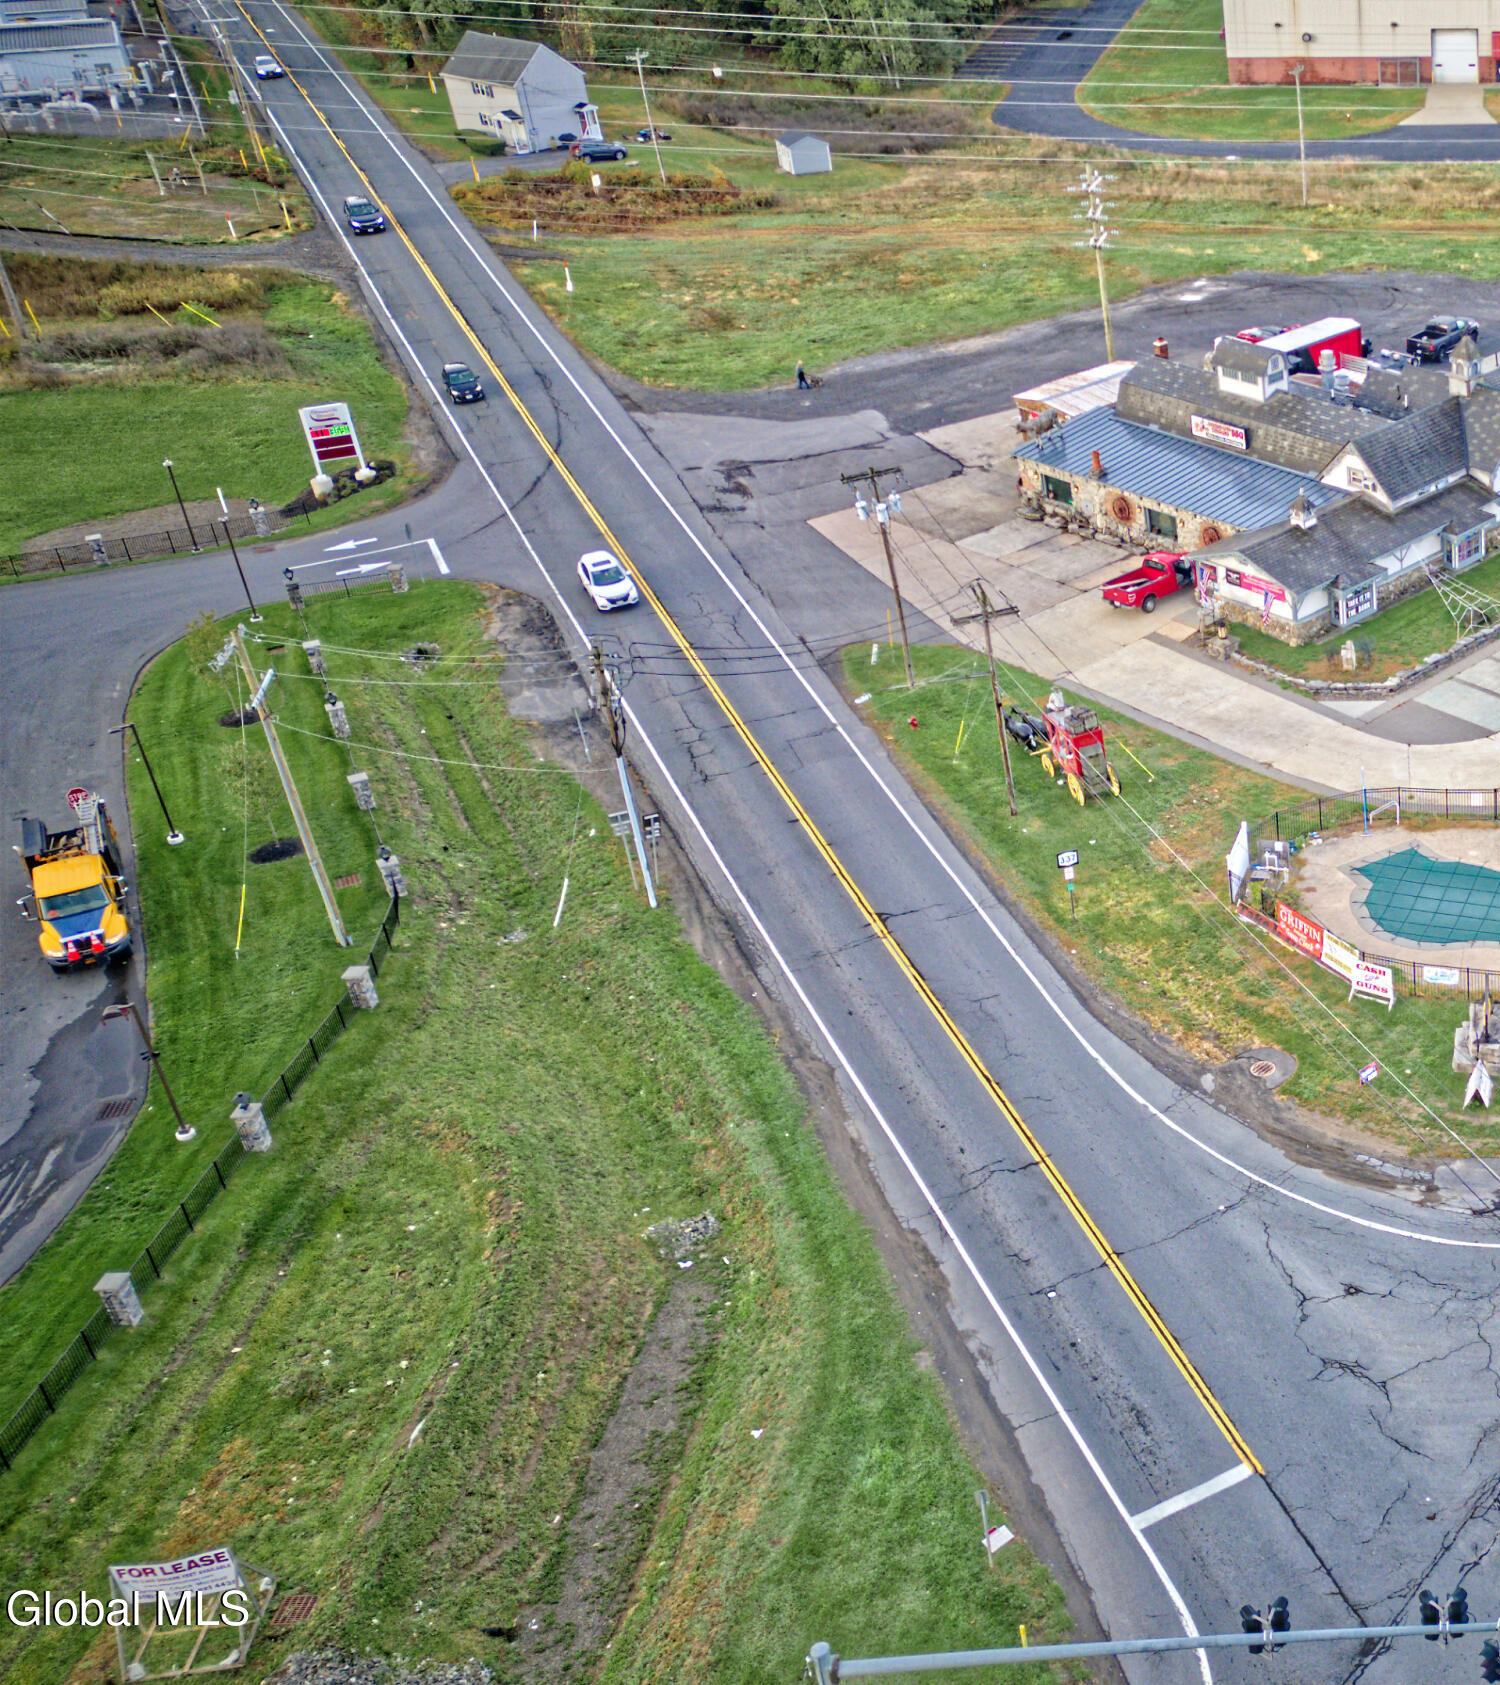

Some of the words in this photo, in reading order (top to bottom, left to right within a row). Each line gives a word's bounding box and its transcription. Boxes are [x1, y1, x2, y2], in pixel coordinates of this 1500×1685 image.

[1279, 909, 1321, 943] GRIFFIN
[1356, 963, 1386, 977] CASH
[1356, 981, 1389, 994] GUNS
[116, 1567, 158, 1579] FOR
[159, 1551, 230, 1576] LEASE
